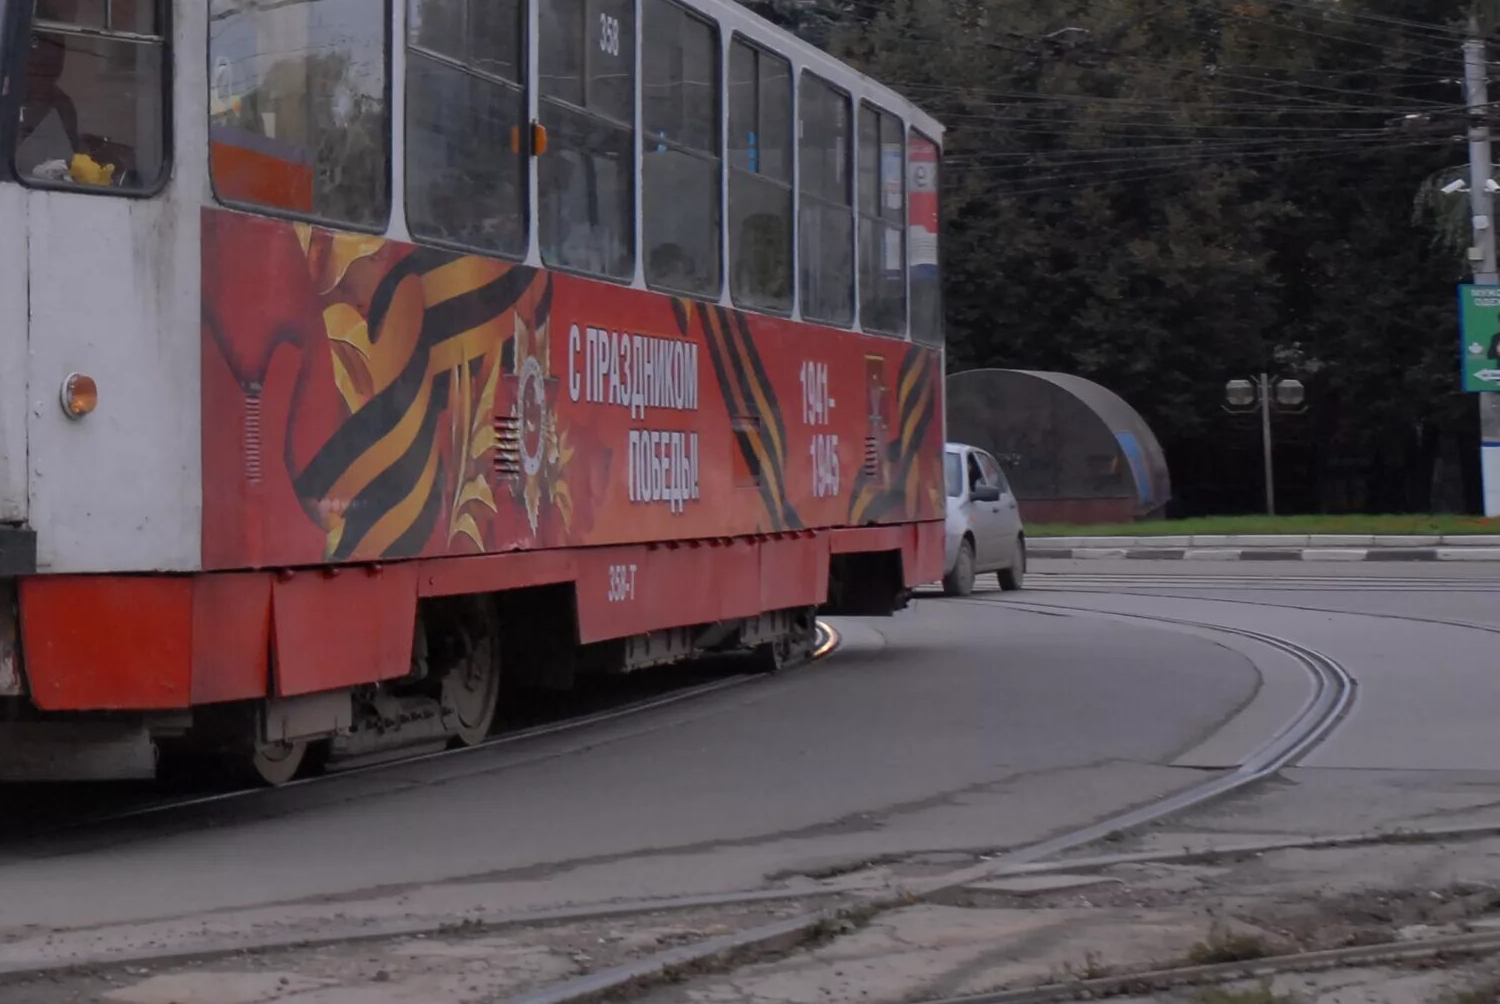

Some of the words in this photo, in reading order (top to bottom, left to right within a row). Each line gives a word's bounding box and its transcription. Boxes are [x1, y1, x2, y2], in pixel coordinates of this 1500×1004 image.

[600, 12, 620, 57] 358
[568, 323, 581, 402] С
[586, 327, 699, 420] ПРАЗДНИКОМ
[628, 429, 700, 514] ПОБЕДЫ!
[810, 433, 840, 498] 1945
